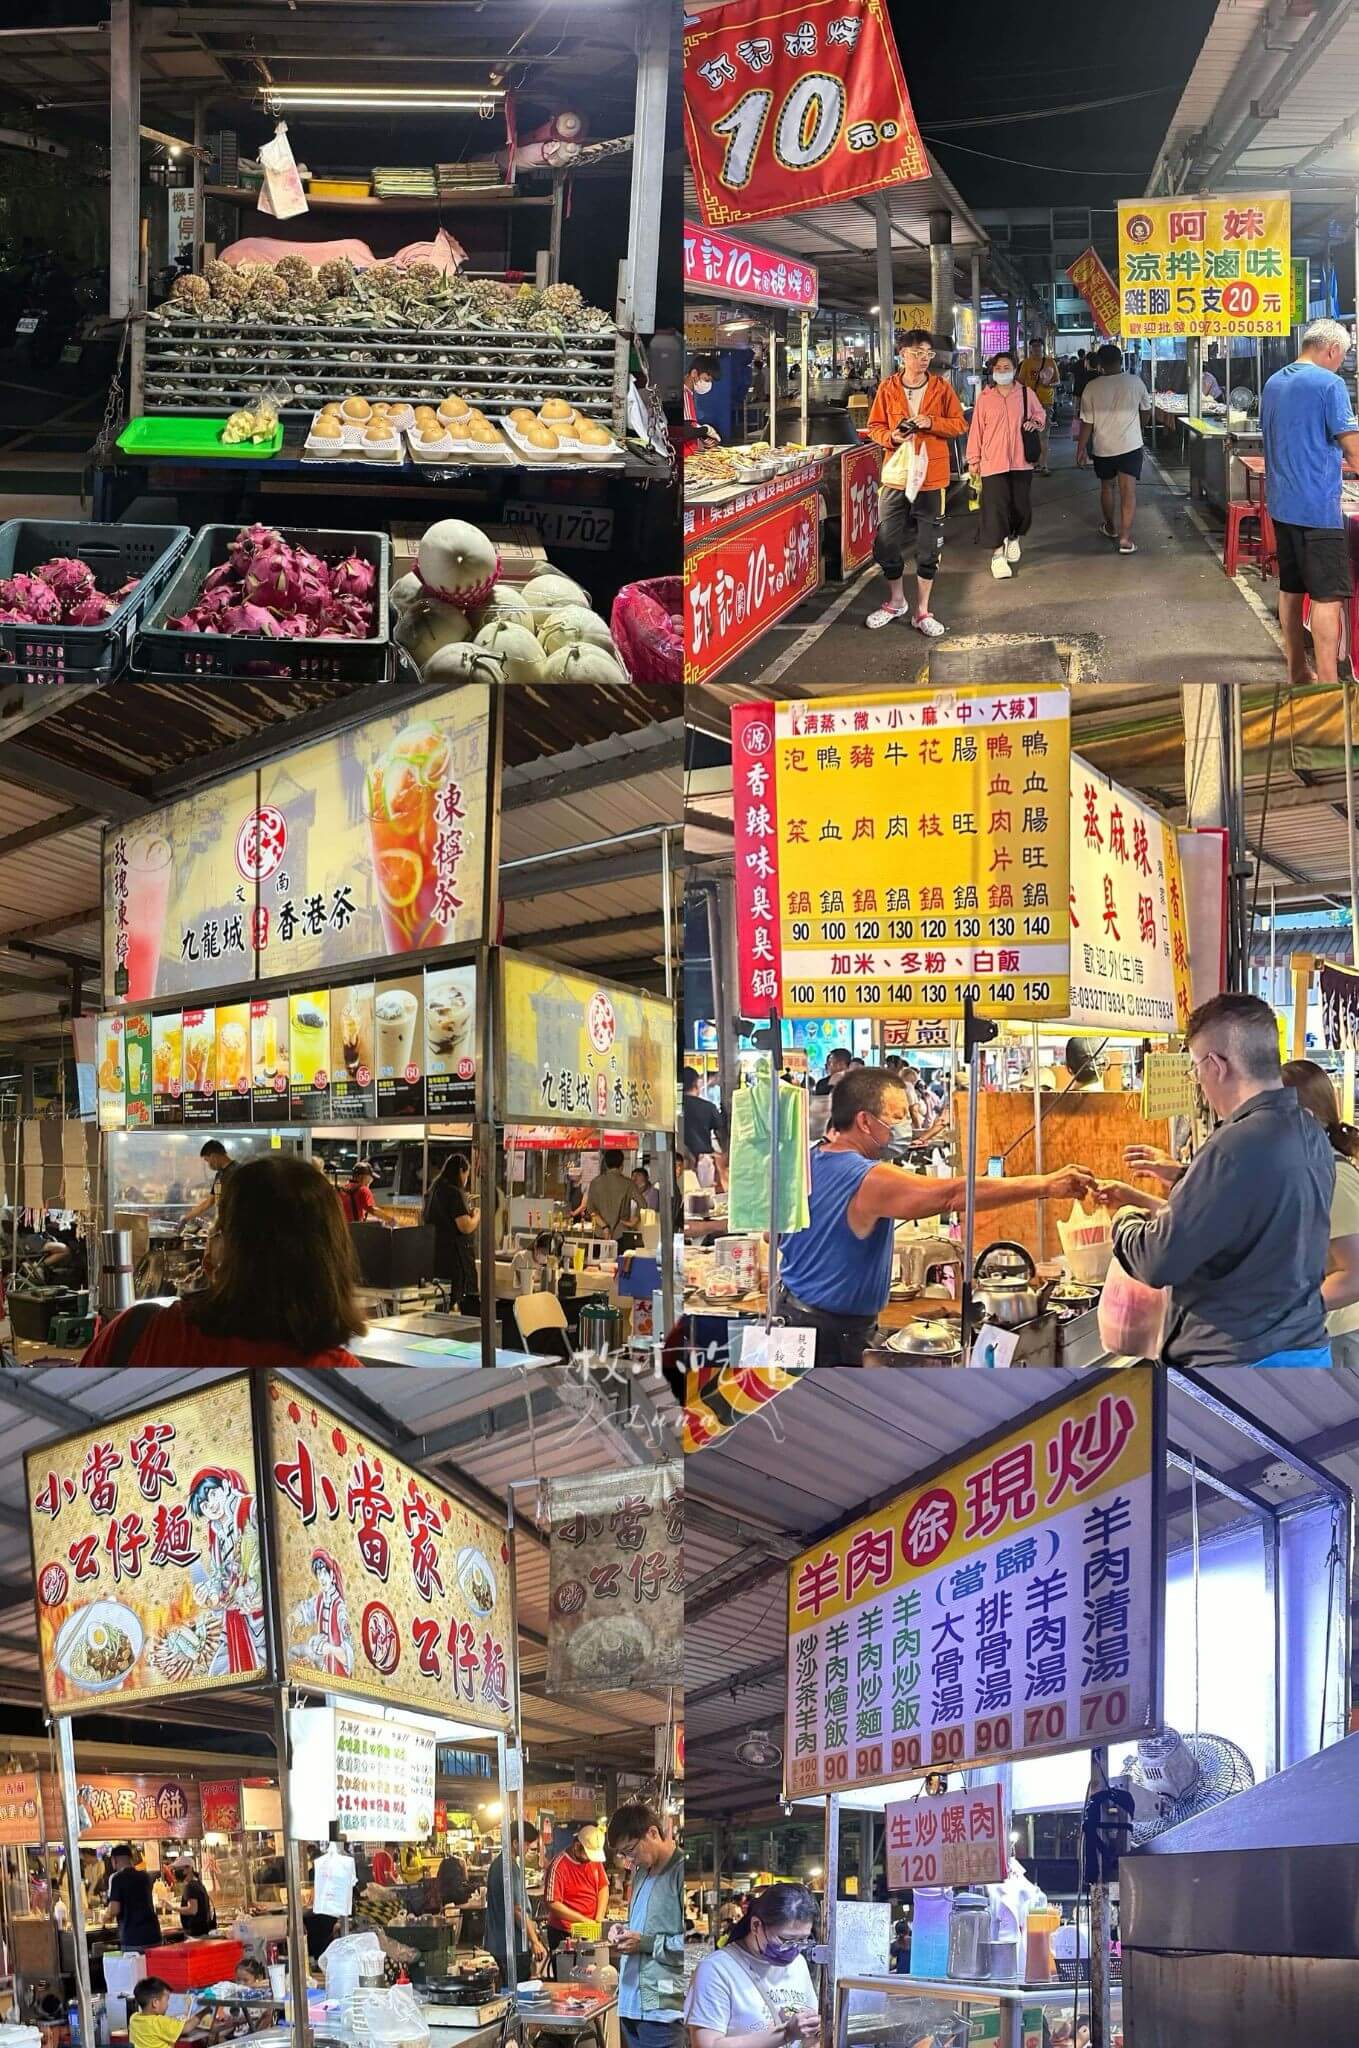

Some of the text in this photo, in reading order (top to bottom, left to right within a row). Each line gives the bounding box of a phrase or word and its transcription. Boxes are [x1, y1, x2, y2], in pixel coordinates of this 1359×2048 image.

[1168, 208, 1265, 244] 阿妹
[1126, 248, 1282, 282] 涼拌滷味
[1189, 320, 1283, 334] 0973-050581
[114, 836, 131, 1000] 玫瑰凍檸
[275, 886, 357, 944] 香港茶
[792, 916, 1050, 940] 90 100 120 130 120 130 130 140
[180, 914, 246, 961] 九龍城
[831, 949, 1020, 975] 加米、冬粉、白飯
[790, 982, 1050, 1003] 100 110 130 140 130 140 140 150
[1135, 996, 1174, 1020] 0932779834
[459, 1060, 474, 1076] 60
[541, 1069, 592, 1112] 九龍城
[35, 1423, 177, 1520] 小當家
[274, 1438, 446, 1602] 小當家
[1081, 1495, 1132, 1688] 羊肉清湯
[975, 1590, 1013, 1714] 排骨湯
[1024, 1567, 1068, 1702] 羊肉湯
[856, 1605, 883, 1741] 羊肉炒麵
[892, 1588, 921, 1734] 羊肉炒飯
[931, 1611, 965, 1725] 大骨湯
[795, 1633, 818, 1754] 炒沙茶羊肉
[825, 1620, 849, 1751] 羊肉燴飯
[1026, 1704, 1066, 1737] 70
[1083, 1689, 1127, 1732] 70
[892, 1741, 921, 1770] 90
[932, 1730, 964, 1763] 90
[976, 1724, 1011, 1755] 90
[825, 1755, 847, 1781] 90
[857, 1748, 883, 1776] 90
[890, 1802, 996, 1850] 生炒螺肉
[901, 1853, 937, 1882] 120
